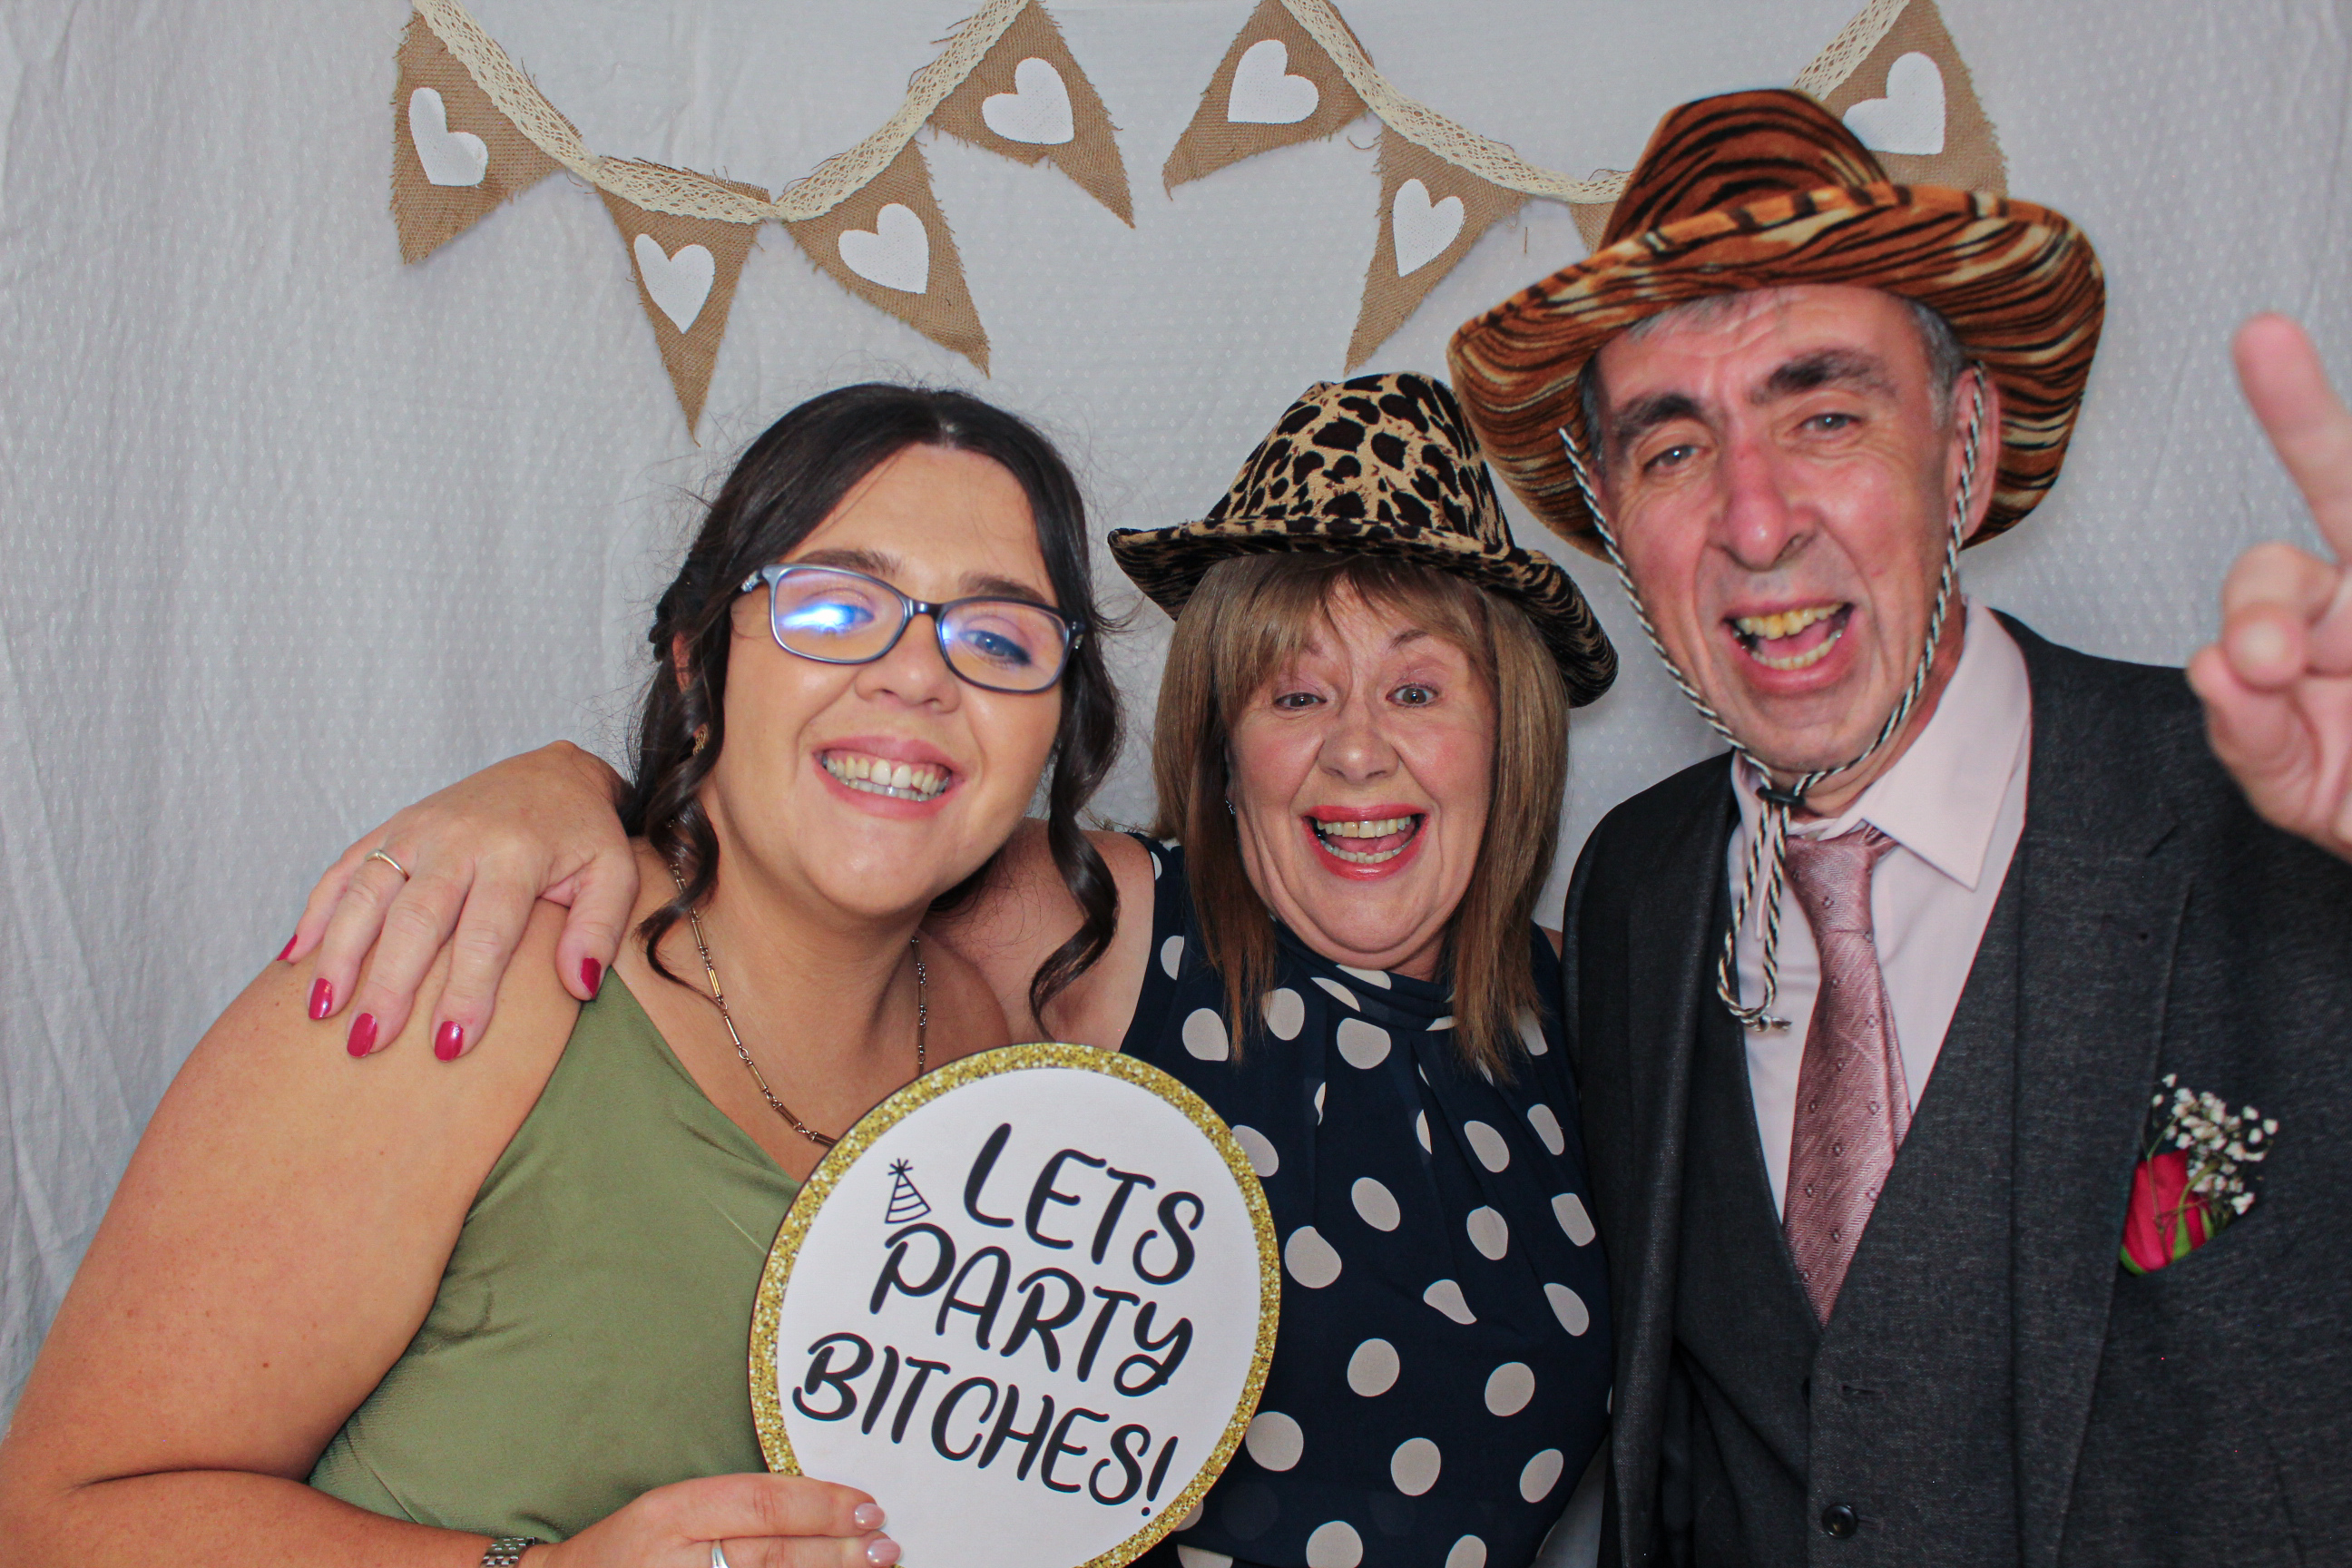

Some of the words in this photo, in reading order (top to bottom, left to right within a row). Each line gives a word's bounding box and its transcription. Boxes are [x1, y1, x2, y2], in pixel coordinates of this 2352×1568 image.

[963, 1122, 1205, 1286] LETS
[868, 1222, 1194, 1398] PARTY
[791, 1331, 1180, 1517] BITCHES!
